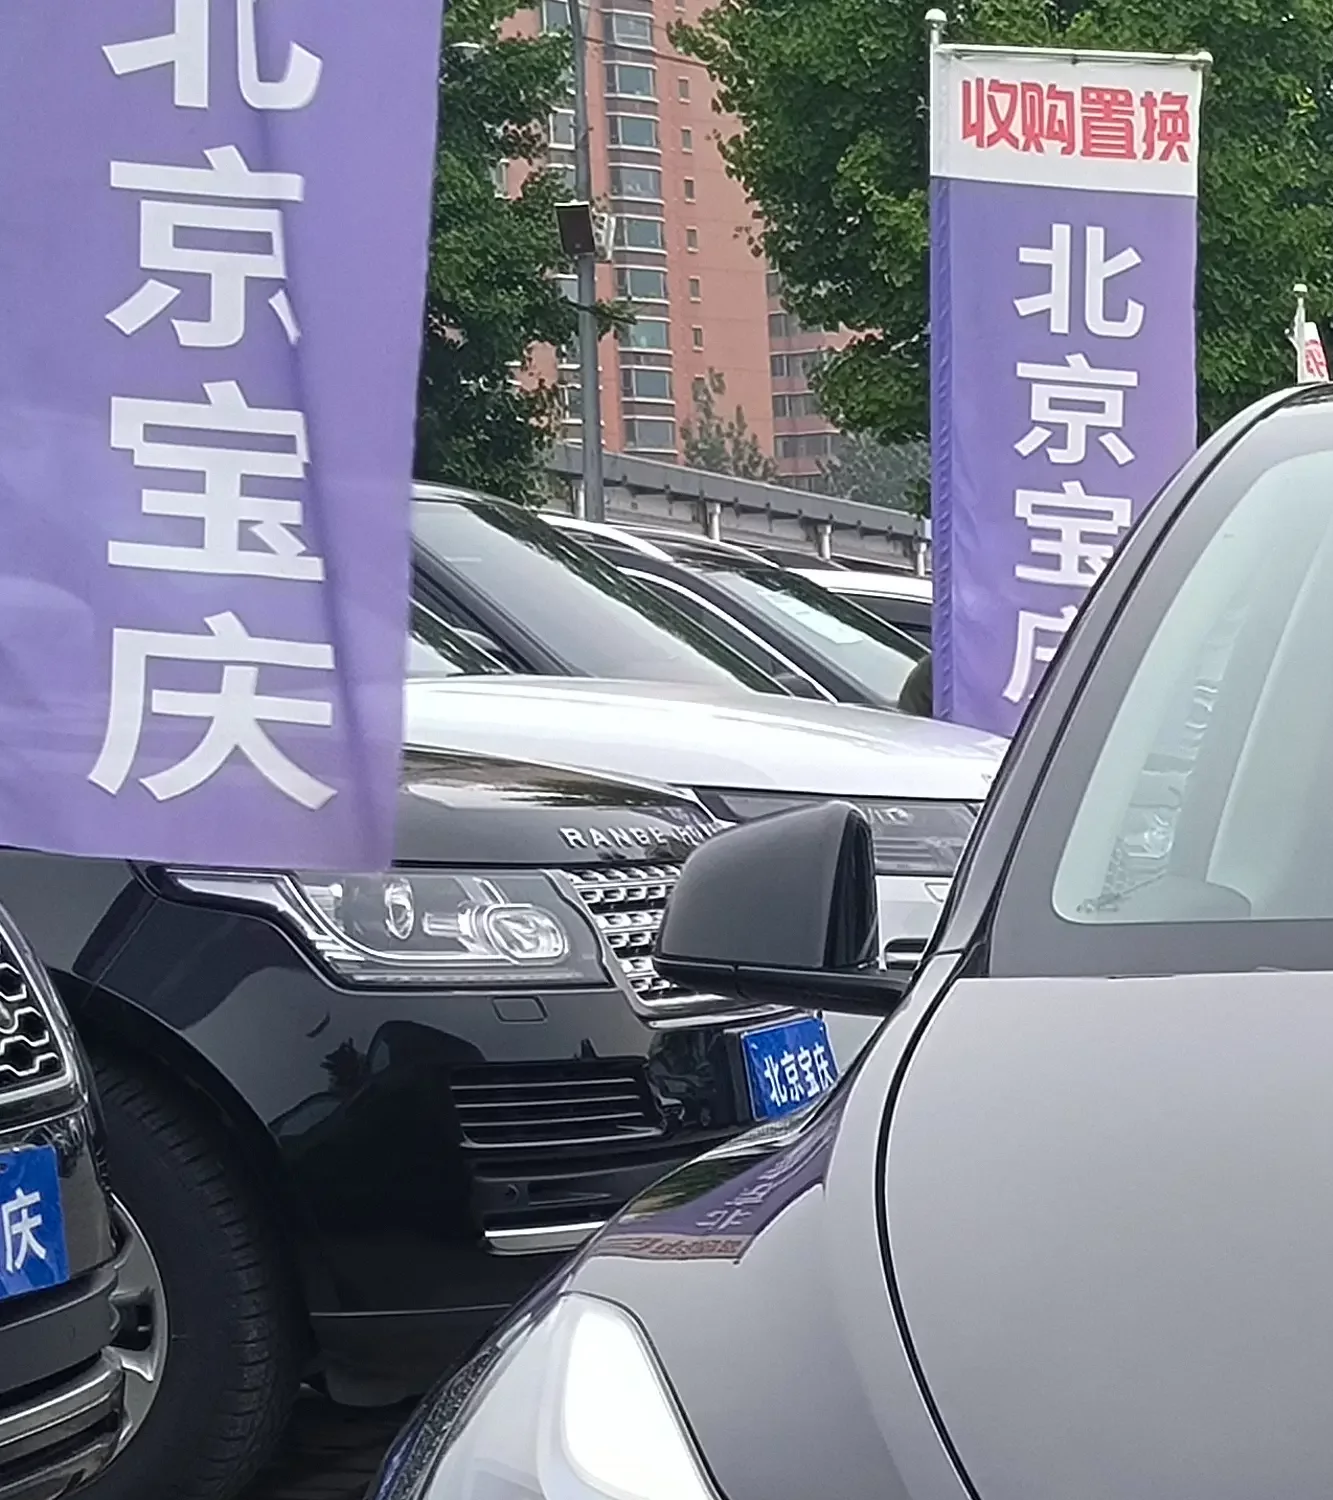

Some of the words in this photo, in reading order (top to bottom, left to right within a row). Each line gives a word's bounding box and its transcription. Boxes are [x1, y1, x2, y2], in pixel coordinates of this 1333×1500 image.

[961, 77, 1191, 163] 收购置换
[88, 0, 338, 811] 北京宝庆
[763, 1041, 835, 1107] 北京宝庆
[0, 1186, 47, 1274] 庆
